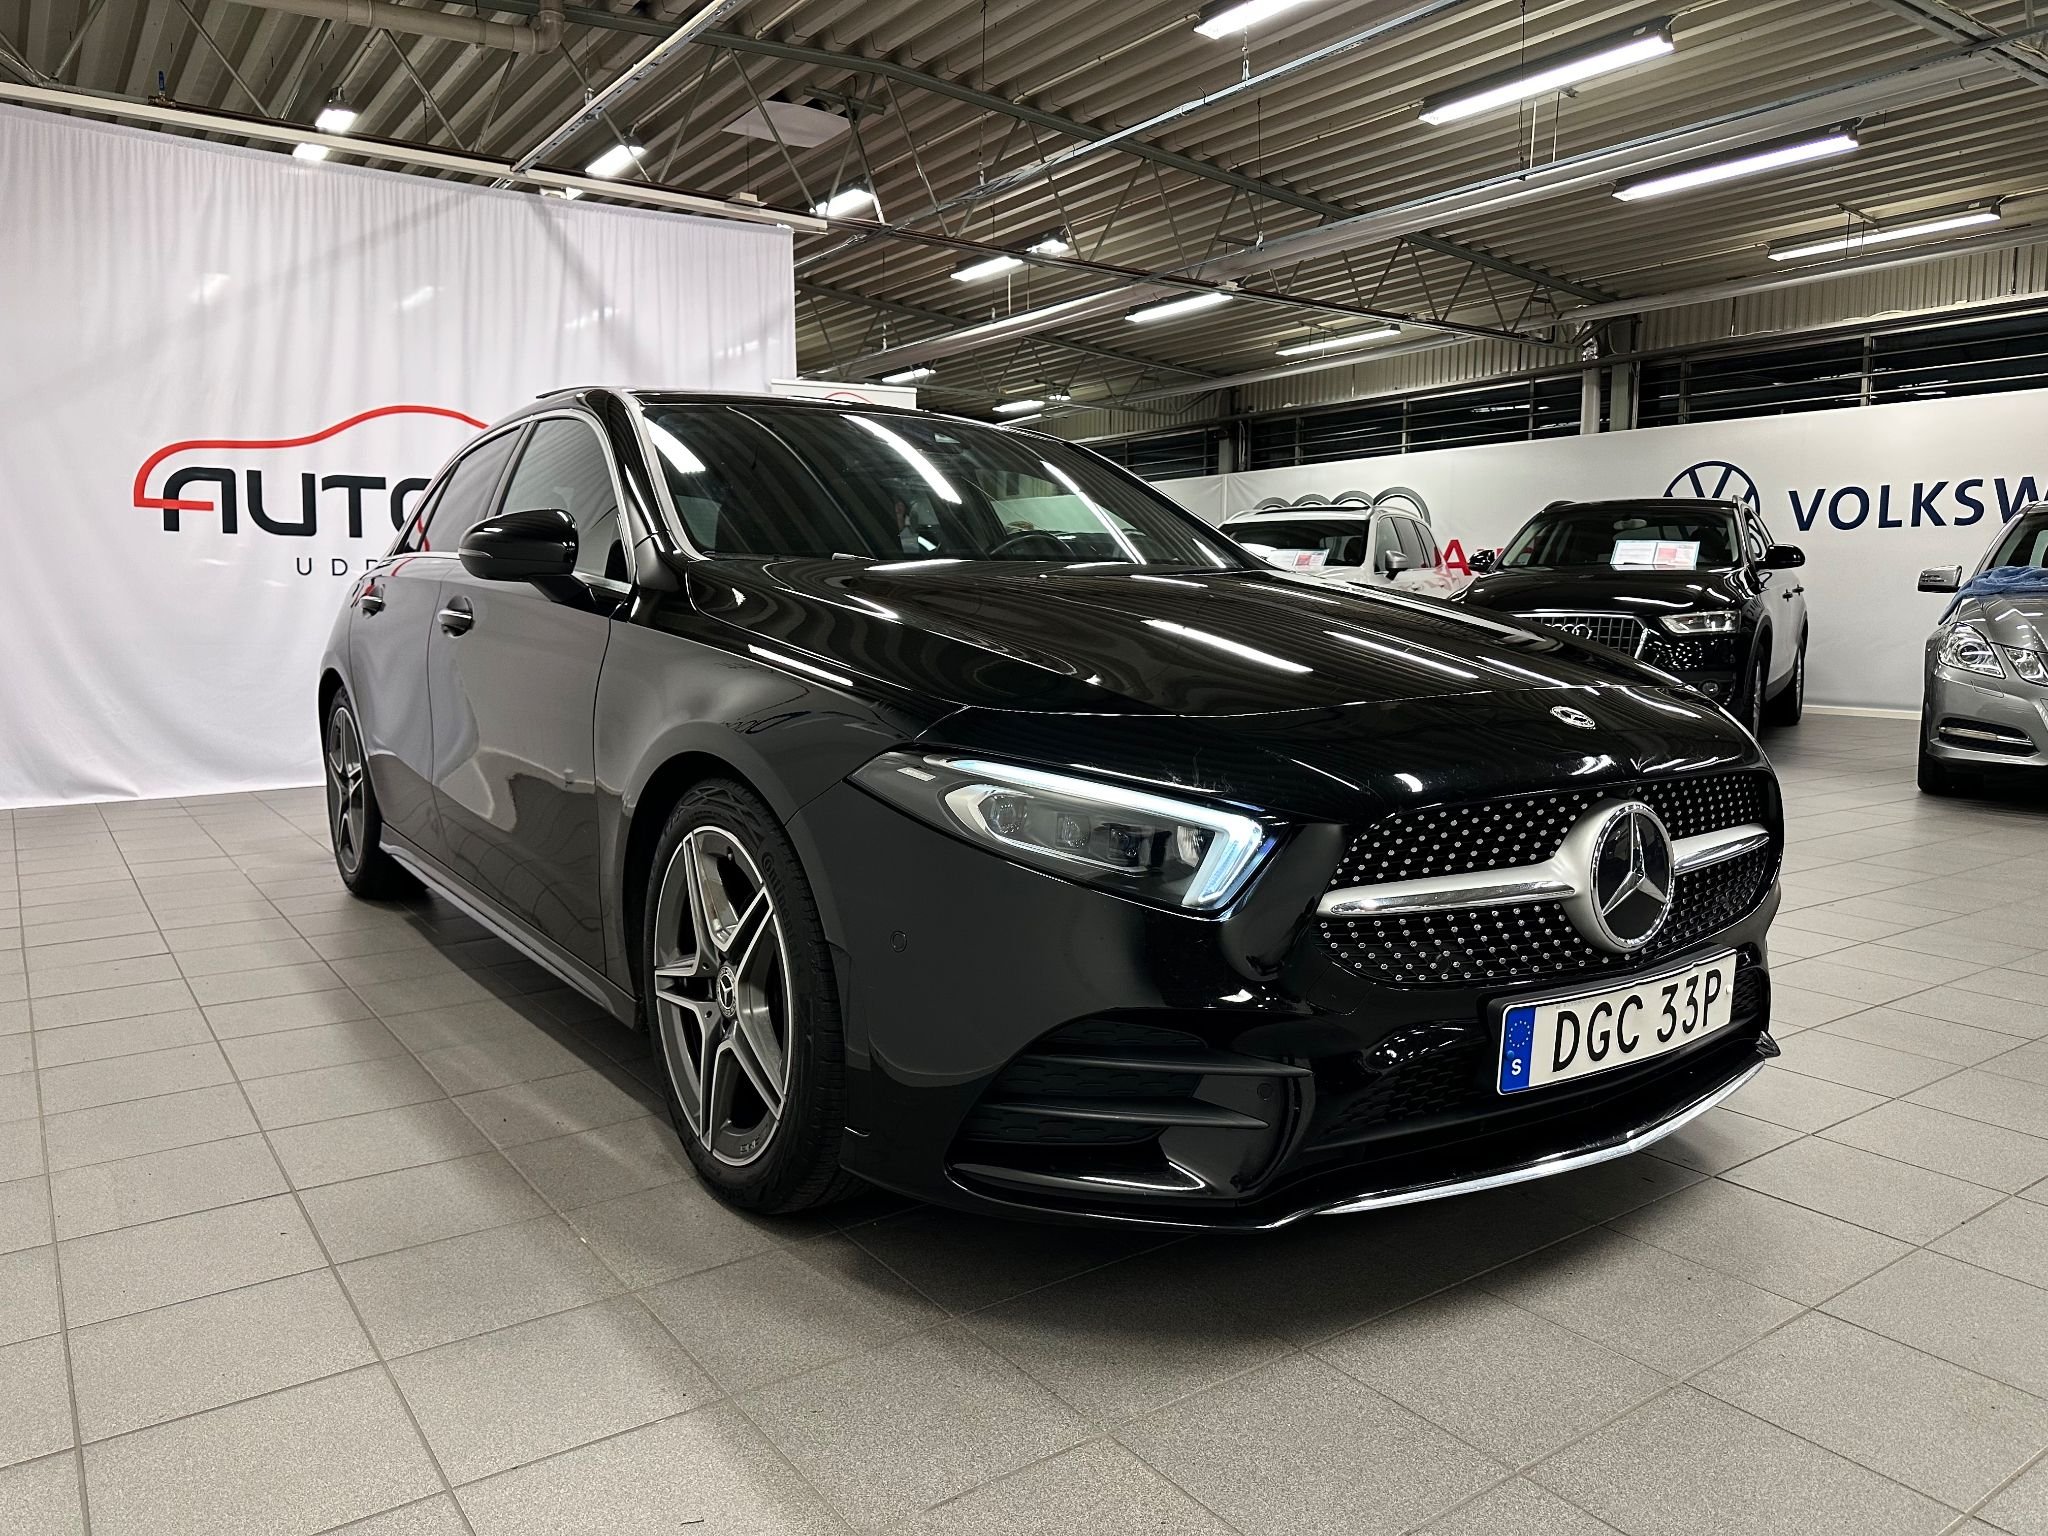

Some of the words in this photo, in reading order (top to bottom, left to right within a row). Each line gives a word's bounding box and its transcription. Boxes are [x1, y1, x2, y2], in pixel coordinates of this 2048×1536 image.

[1788, 476, 2048, 530] VOLKSW
[1552, 995, 1643, 1073] DGC
[1656, 968, 1722, 1043] 33P
[1510, 1059, 1522, 1076] S
